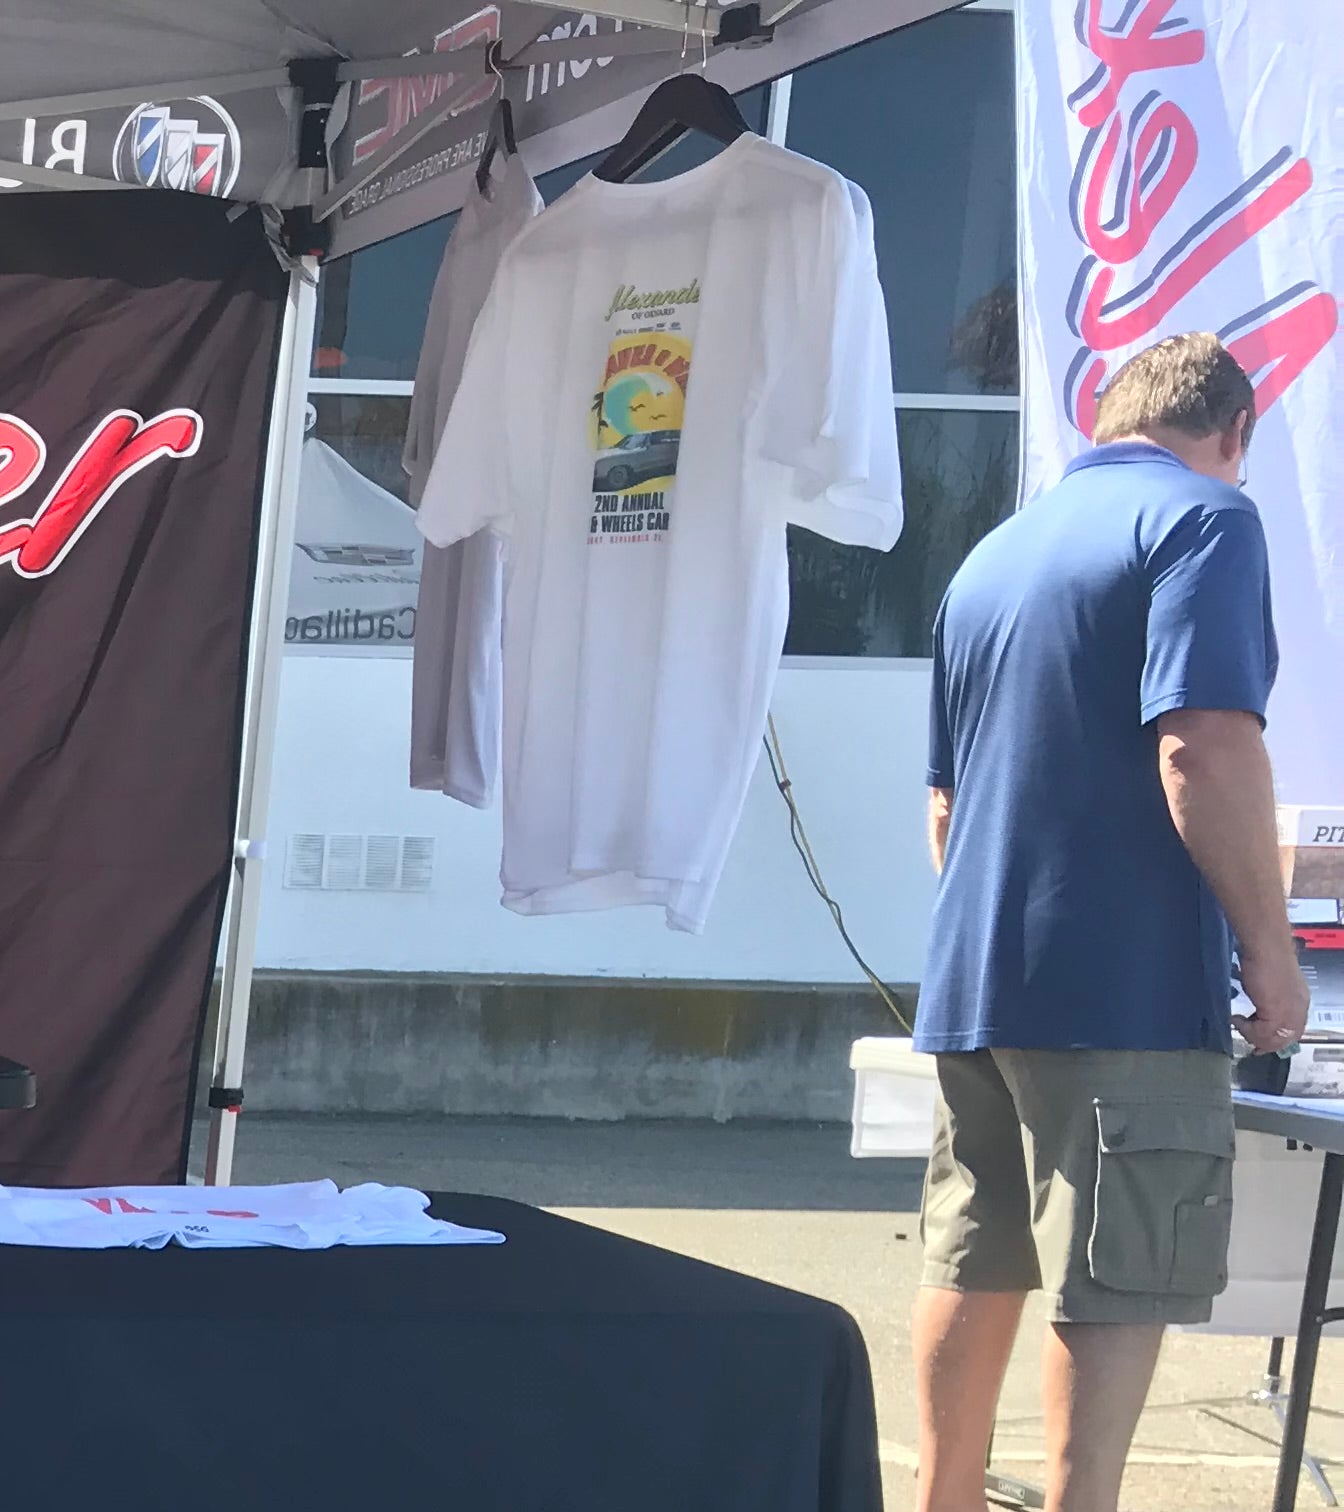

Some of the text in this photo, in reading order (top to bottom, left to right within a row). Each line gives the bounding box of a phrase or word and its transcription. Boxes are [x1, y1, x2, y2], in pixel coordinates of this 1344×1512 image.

[594, 492, 665, 513] 2ND ANNUAL
[601, 514, 644, 533] WHEELS
